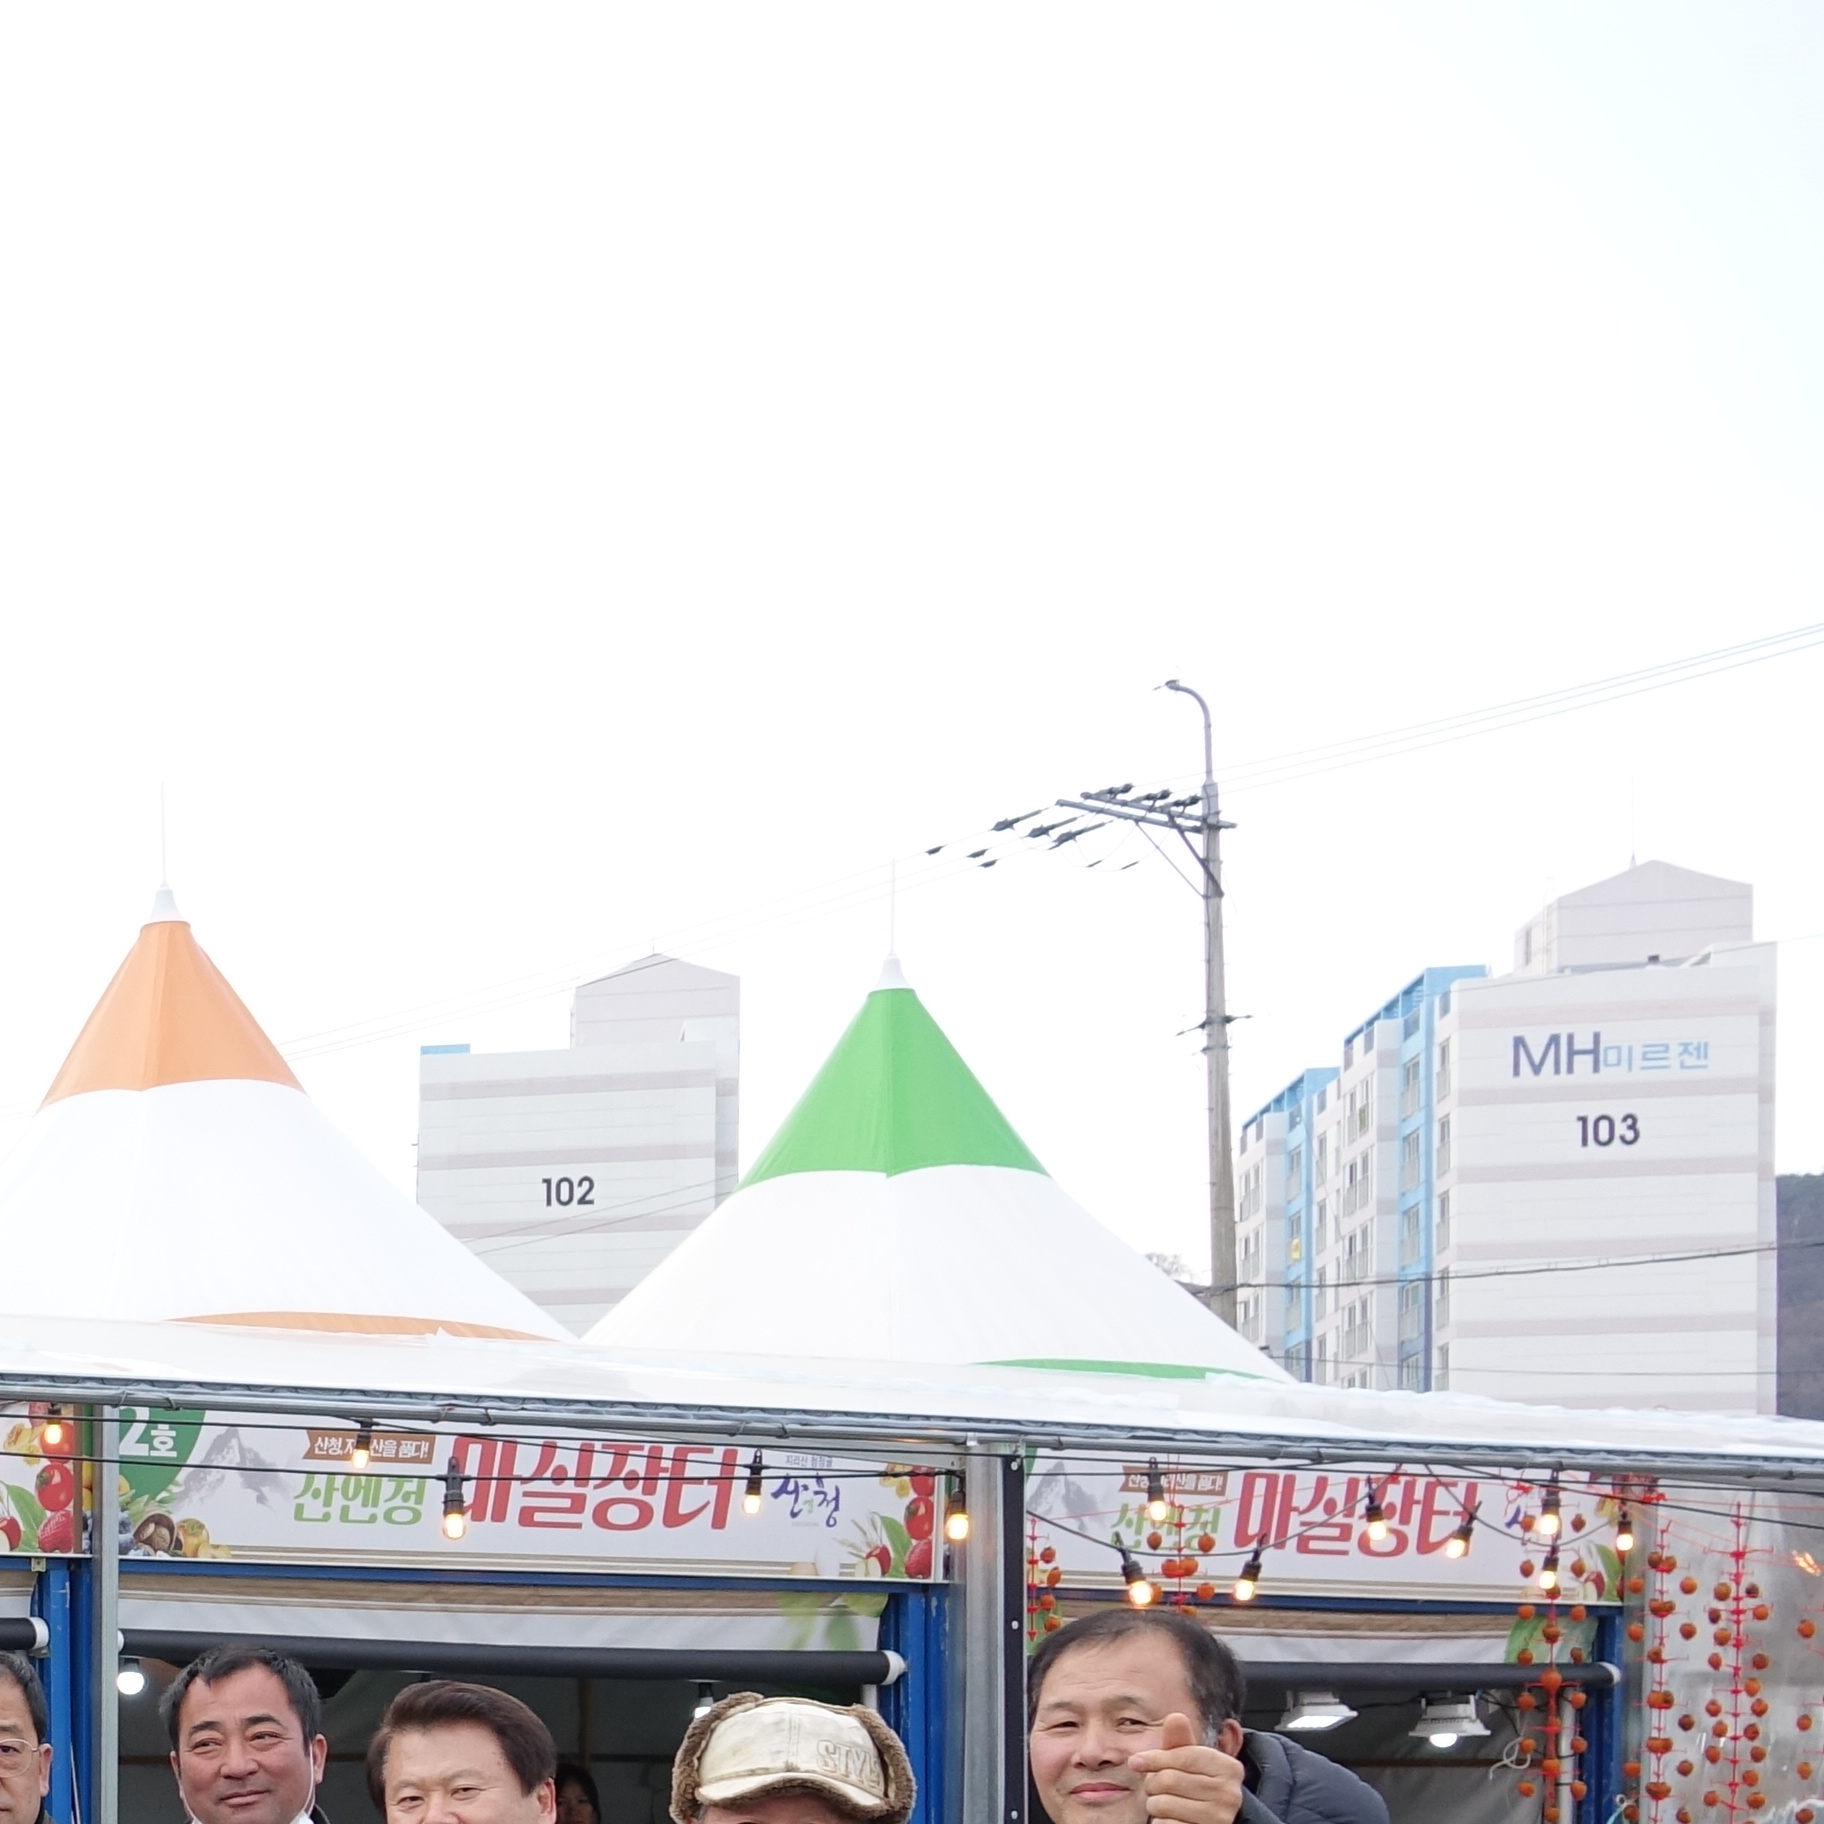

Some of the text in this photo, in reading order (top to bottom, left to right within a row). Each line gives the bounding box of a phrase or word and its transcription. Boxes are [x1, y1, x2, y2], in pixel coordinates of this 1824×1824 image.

[1576, 1114, 1642, 1147] 103
[542, 1176, 595, 1207] 102
[294, 1473, 427, 1525] 산엔청
[451, 1434, 738, 1531] 마실장터
